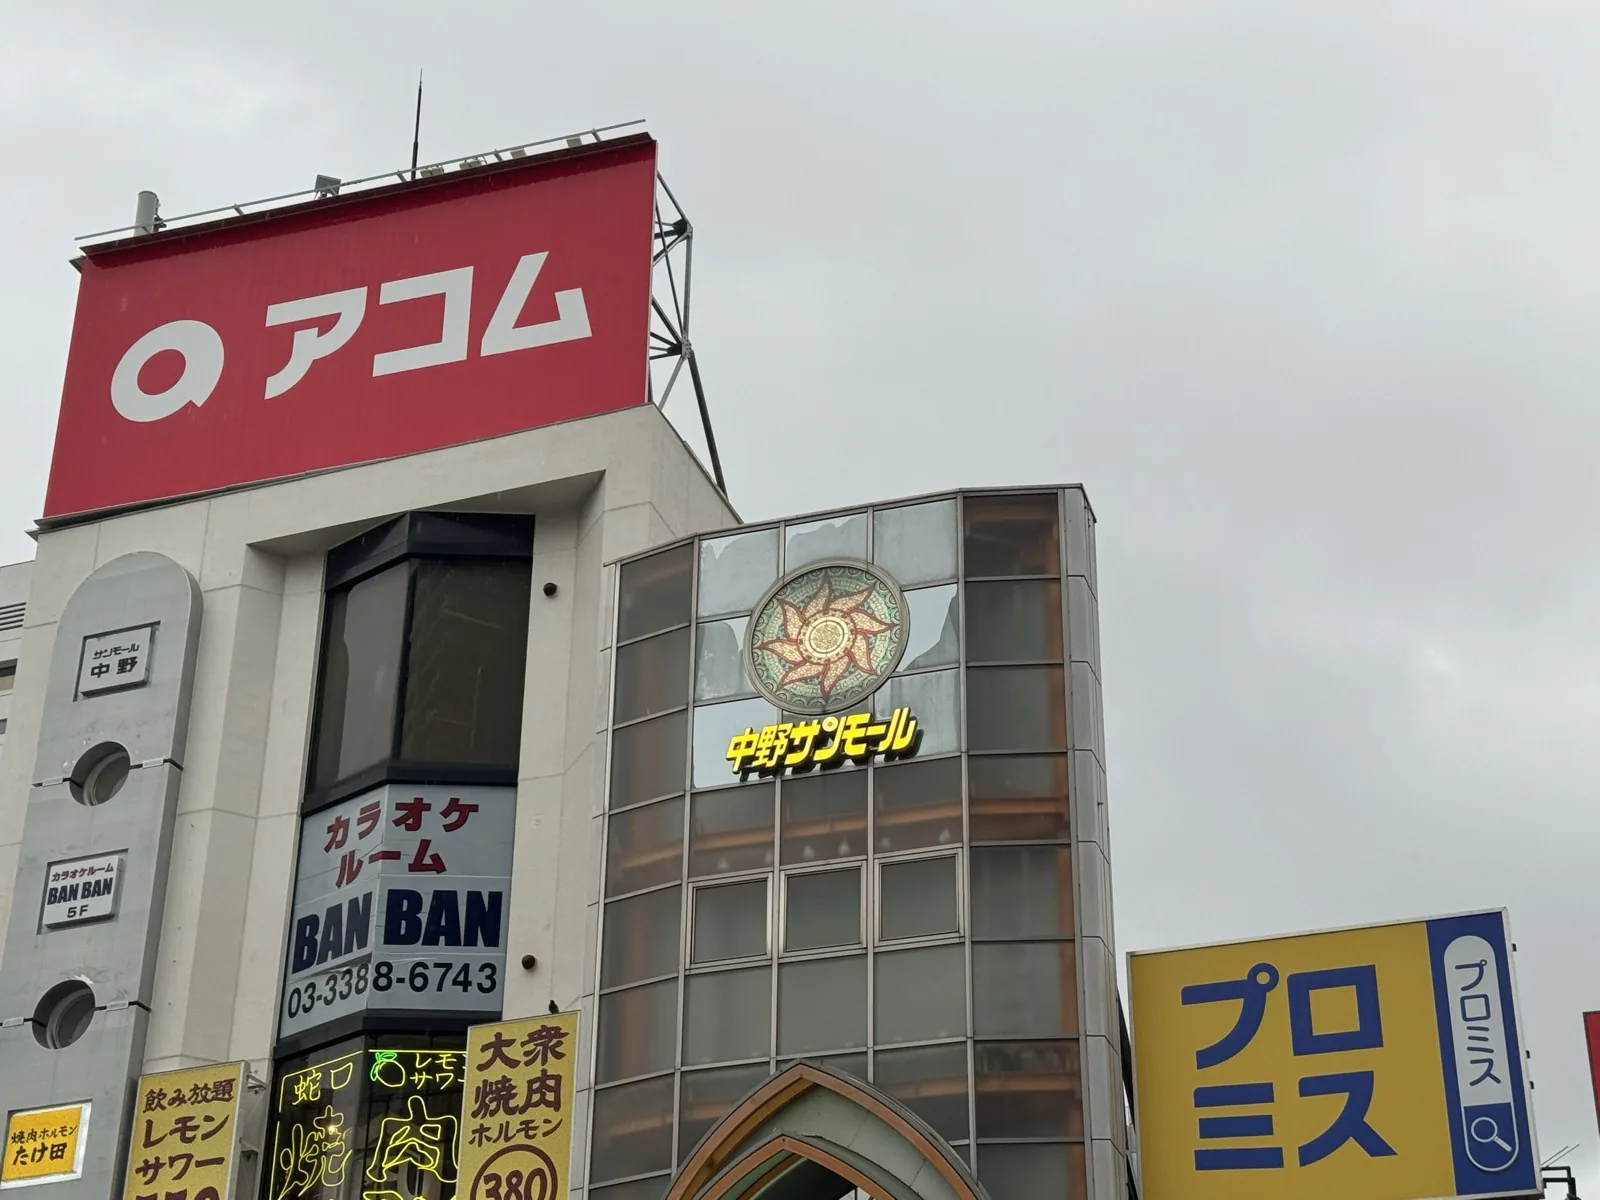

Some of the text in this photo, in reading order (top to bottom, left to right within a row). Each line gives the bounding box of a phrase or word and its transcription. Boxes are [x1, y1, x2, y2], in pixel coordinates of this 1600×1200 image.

[264, 250, 593, 400] アコム
[90, 656, 139, 679] 中野
[92, 643, 140, 660] サンモール
[725, 706, 918, 775] 中野サンモール
[323, 797, 480, 853] カラオケ
[51, 862, 115, 882] カラオケルーム
[335, 839, 447, 889] ルーム
[46, 876, 114, 906] BAN BAN
[66, 904, 89, 919] 5F
[290, 888, 503, 975] BAN BAN
[287, 960, 498, 1019] 03-3388-6743
[1180, 961, 1384, 1070] プロ
[1454, 958, 1502, 1087] プロミス
[475, 1024, 570, 1072] 大衆
[142, 1077, 237, 1114] 飲み放題
[470, 1068, 563, 1119] 焼肉
[11, 1124, 78, 1145] 焼肉ホルモン
[142, 1114, 230, 1149] レモン
[468, 1117, 564, 1148] ホルモン
[1193, 1069, 1398, 1171] ミス
[12, 1142, 68, 1166] たけ田
[134, 1152, 225, 1186] サワー
